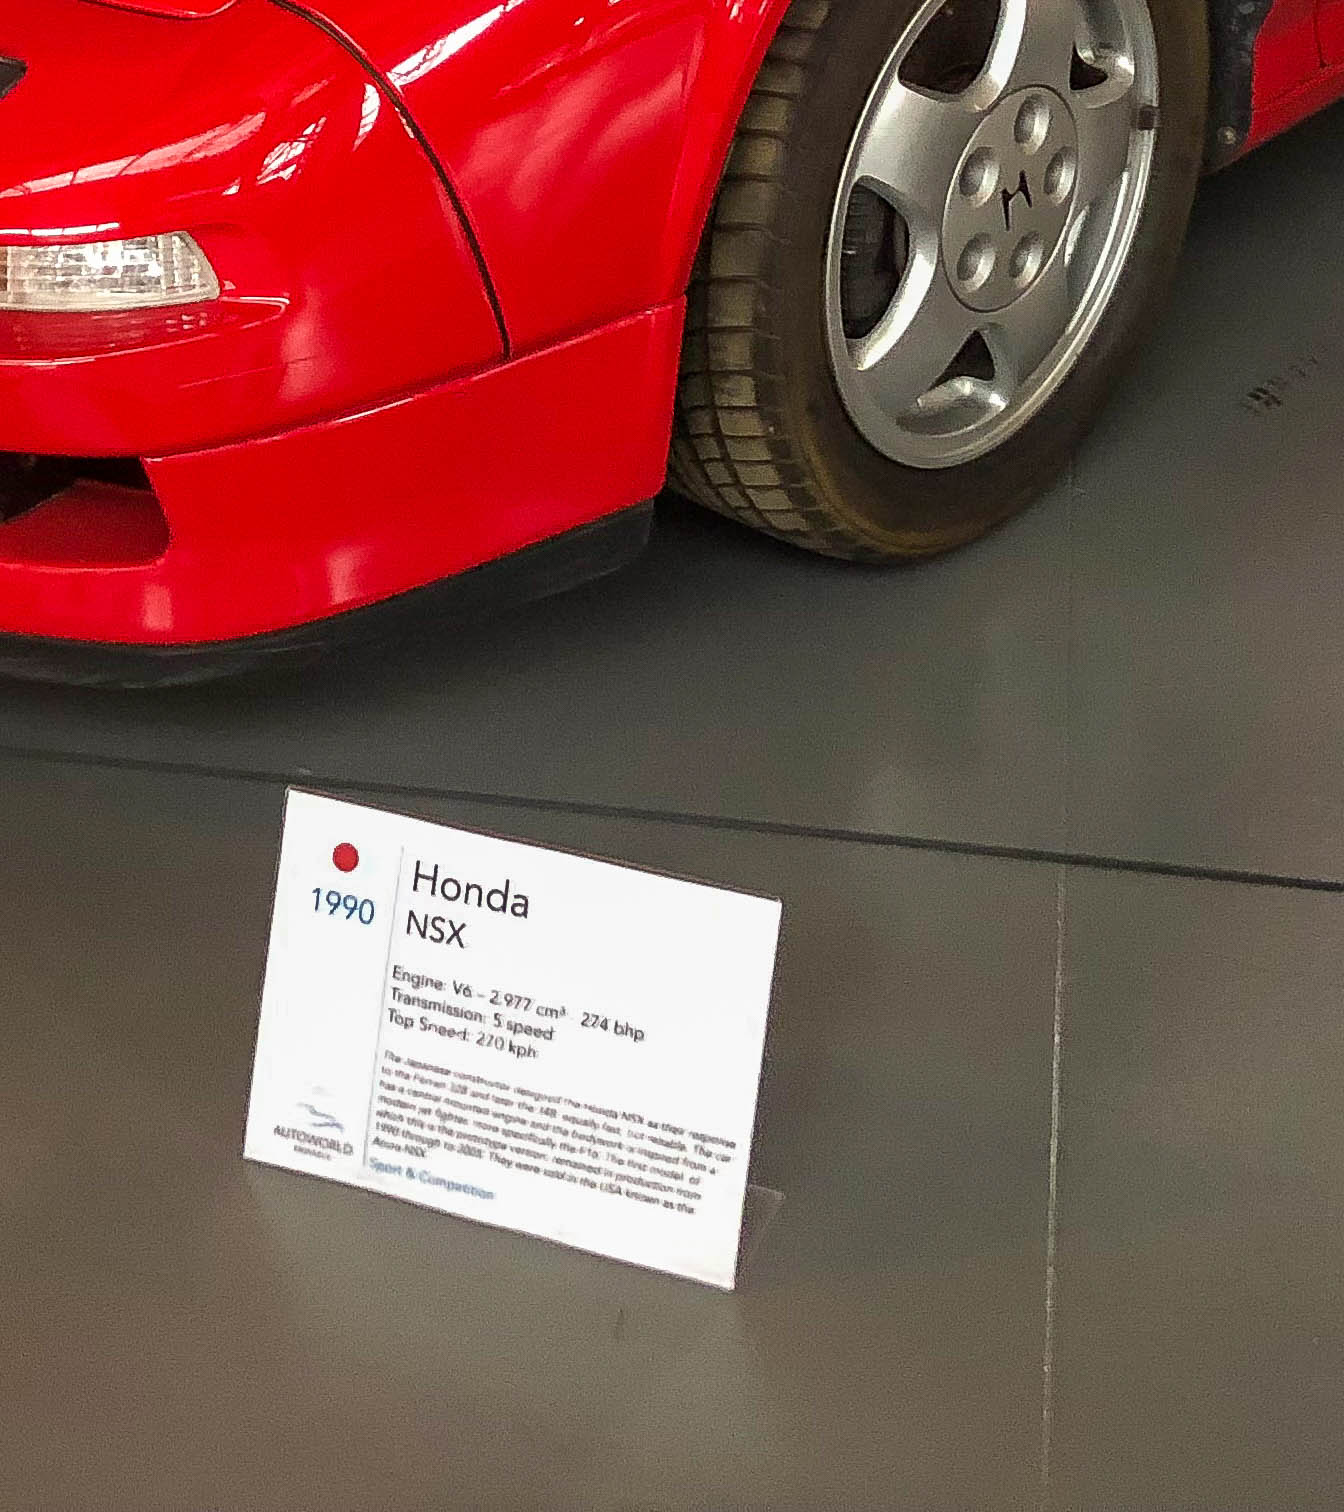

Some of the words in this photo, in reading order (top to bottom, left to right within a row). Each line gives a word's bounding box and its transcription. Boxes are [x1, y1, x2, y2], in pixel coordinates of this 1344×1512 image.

[312, 888, 374, 925] 1990
[413, 860, 529, 919] Honda
[406, 910, 467, 949] NSX
[392, 965, 446, 991] Engine:
[453, 980, 472, 998] V6
[581, 1012, 610, 1031] 274
[614, 1020, 644, 1043] bhp
[388, 1008, 414, 1029] Top
[476, 1031, 504, 1050] 270
[509, 1040, 537, 1058] kph
[494, 1013, 502, 1028] 5
[507, 1021, 556, 1040] speed
